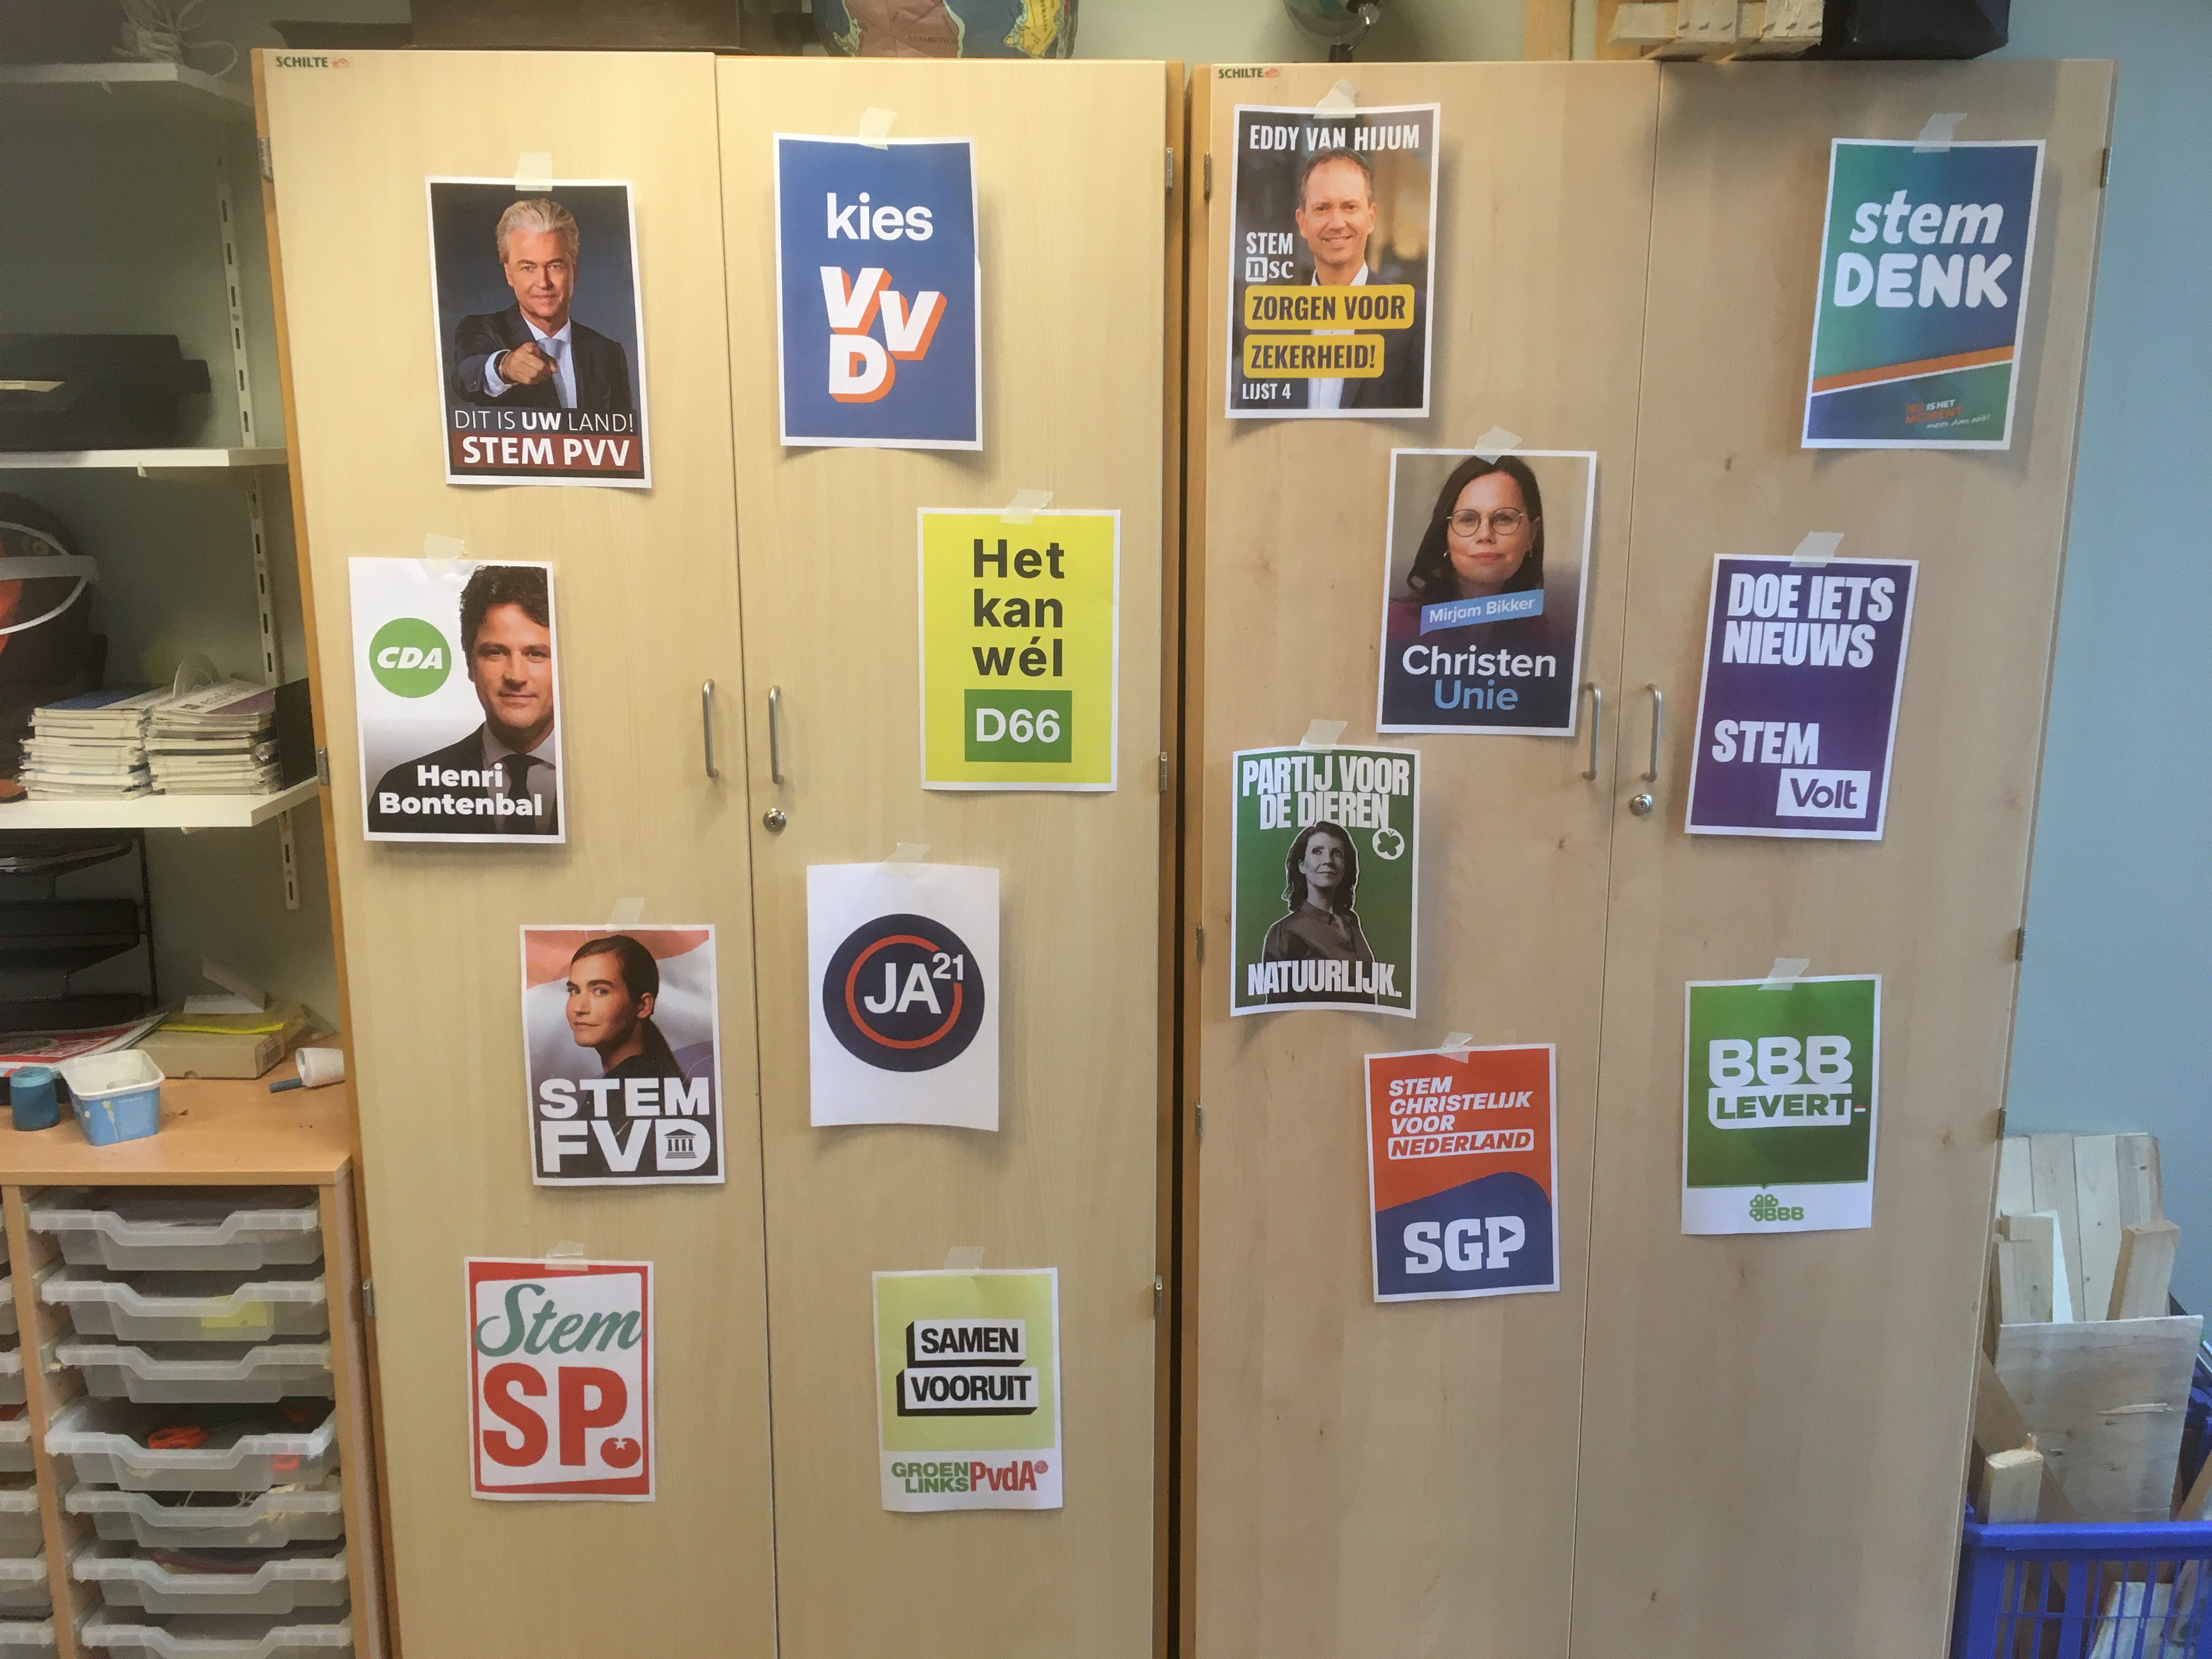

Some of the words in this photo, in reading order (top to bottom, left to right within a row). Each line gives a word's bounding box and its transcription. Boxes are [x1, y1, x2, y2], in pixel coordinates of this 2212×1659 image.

[907, 35, 957, 44] ANTARCTICA
[275, 56, 329, 67] SCHILTE
[1218, 67, 1263, 78] SCHILTE
[1249, 124, 1298, 151] EDDY
[1307, 126, 1346, 151] VAN
[1354, 124, 1420, 151] HIJUM
[827, 192, 934, 241] kies
[1849, 189, 2004, 244] stem
[1246, 232, 1293, 256] STEM
[1833, 252, 2013, 308] DENK
[1251, 296, 1336, 321] ZORGEN
[1344, 295, 1406, 320] VOOR
[1251, 345, 1376, 369] ZEKERHEID!
[1242, 383, 1278, 400] LIJST
[1282, 382, 1291, 399] 4
[1904, 405, 1964, 424] MOMENT
[1926, 403, 1936, 411] IS
[1937, 399, 1956, 409] HET
[454, 410, 492, 430] DIT
[498, 410, 516, 430] IS
[521, 411, 562, 431] UW
[568, 412, 635, 433] LAND!
[463, 435, 555, 465] STEM
[563, 437, 630, 466] PVV
[973, 539, 1065, 579] Het
[973, 588, 1063, 628] kan
[1728, 572, 1802, 619] DOE
[1807, 575, 1896, 622] IETS
[1429, 606, 1481, 623] Mirjam
[1486, 599, 1535, 615] Bikker
[972, 635, 1063, 677] wél
[1722, 620, 1876, 668] NIEUWS
[376, 646, 443, 670] CDA
[1402, 644, 1556, 678] Christen
[1434, 679, 1519, 710] Unie
[976, 708, 1060, 743] D66
[1711, 719, 1820, 765] STEM
[417, 763, 503, 788] Henri
[1242, 755, 1334, 797] PARTIJ
[1338, 755, 1410, 797] VOOR
[379, 791, 543, 816] Bontenbal
[1790, 777, 1858, 809] Volt
[1260, 792, 1291, 830] DE
[1297, 791, 1390, 829] DIEREN
[1248, 959, 1402, 998] NATUURLIJK.
[1708, 1035, 1853, 1088] BBB
[539, 1077, 710, 1119] STEM
[1388, 1076, 1453, 1096] STEM
[1389, 1091, 1534, 1116] CHRISTELIJK
[1716, 1093, 1852, 1120] LEVERT
[1390, 1114, 1456, 1135] VOOR
[540, 1118, 712, 1173] FVD
[1390, 1131, 1531, 1157] NEDERLAND
[1763, 1206, 1804, 1222] BBB
[1403, 1215, 1526, 1274] SGP
[473, 1283, 645, 1358] Stem
[920, 1327, 1019, 1354] SAMEN
[911, 1375, 1032, 1402] VOORUIT
[891, 1462, 969, 1478] GROEN
[969, 1460, 1037, 1492] PvdA
[905, 1477, 969, 1494] LINKS
